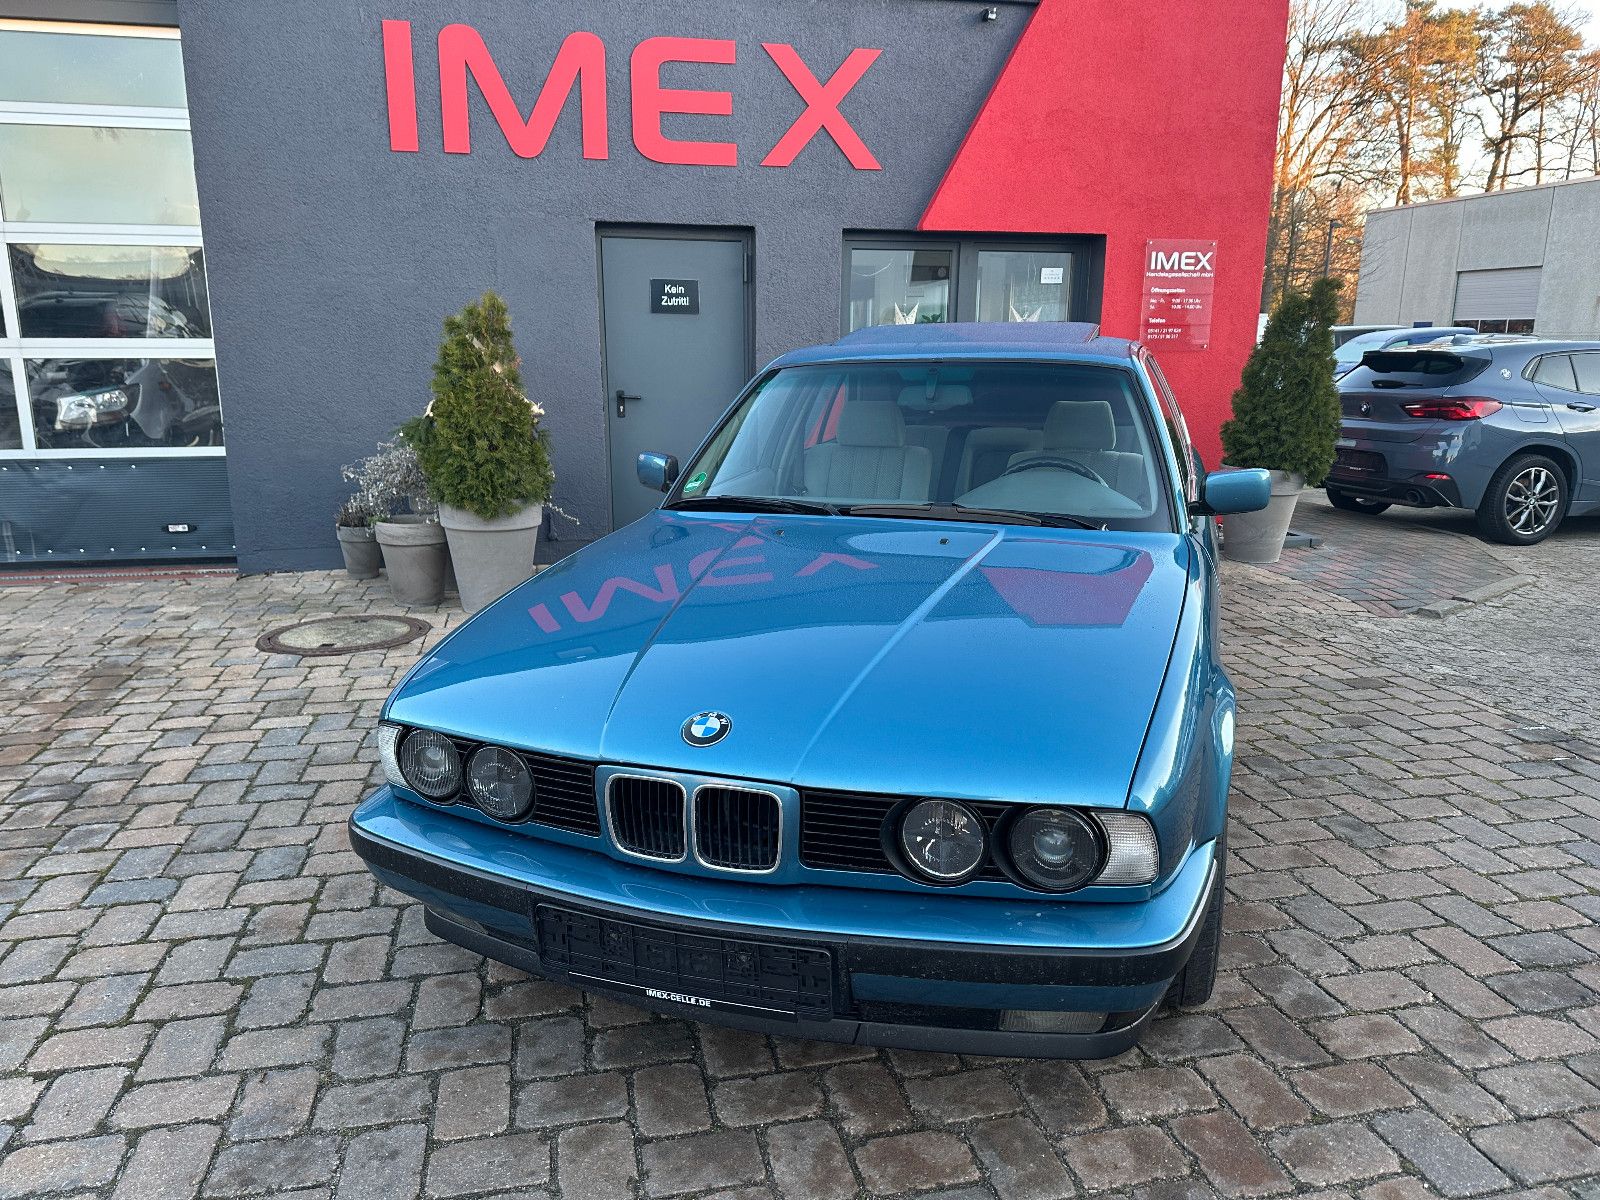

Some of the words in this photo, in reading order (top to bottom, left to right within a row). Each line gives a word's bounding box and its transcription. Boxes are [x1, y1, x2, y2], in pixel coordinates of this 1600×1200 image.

[381, 19, 883, 171] IMEX
[1150, 251, 1213, 271] IMEX
[664, 284, 685, 294] Kein
[646, 989, 711, 1007] IMEX-CELLE.DE
